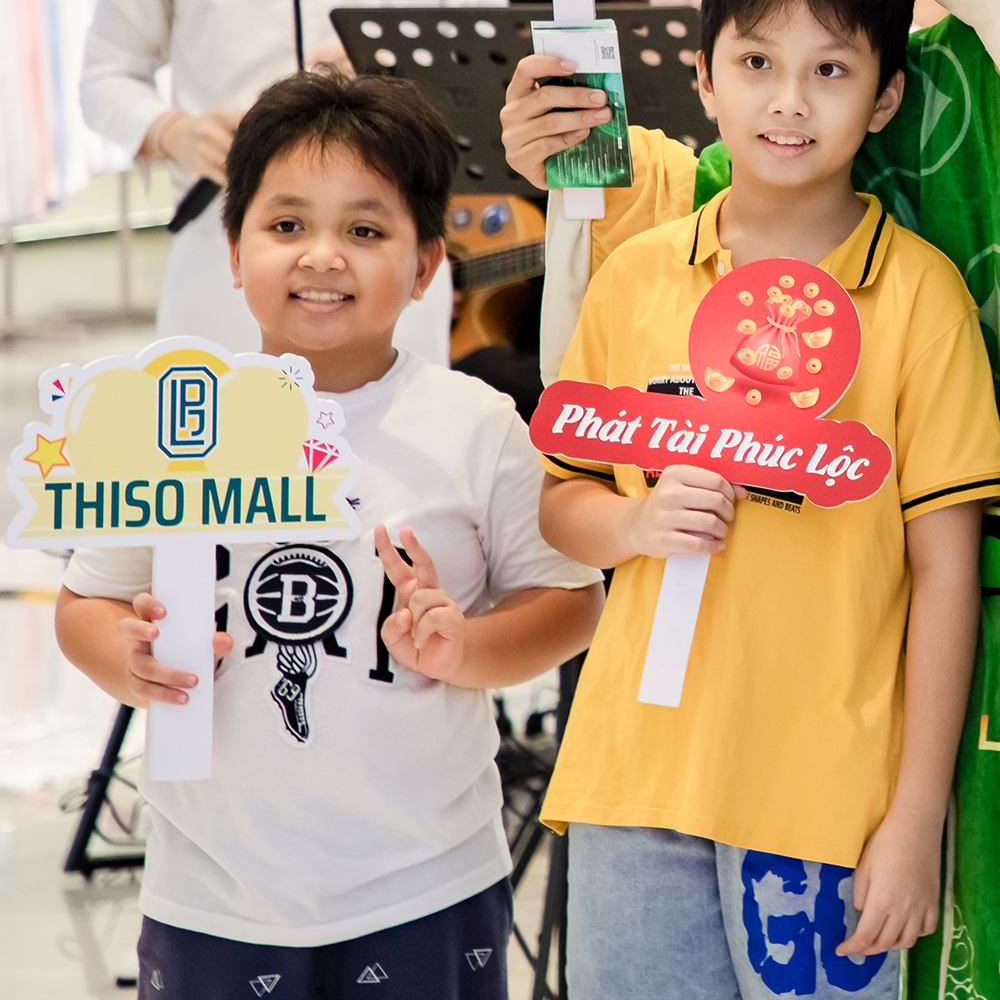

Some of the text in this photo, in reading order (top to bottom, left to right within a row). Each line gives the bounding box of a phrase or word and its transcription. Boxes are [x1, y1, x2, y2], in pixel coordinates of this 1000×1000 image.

[679, 386, 695, 396] THE
[552, 404, 870, 487] Phát Tài Phúc Lộc
[44, 475, 327, 530] THISO MALL
[750, 493, 771, 506] SHAPES
[771, 500, 784, 509] AND
[784, 503, 802, 514] BEATS
[277, 574, 317, 623] B
